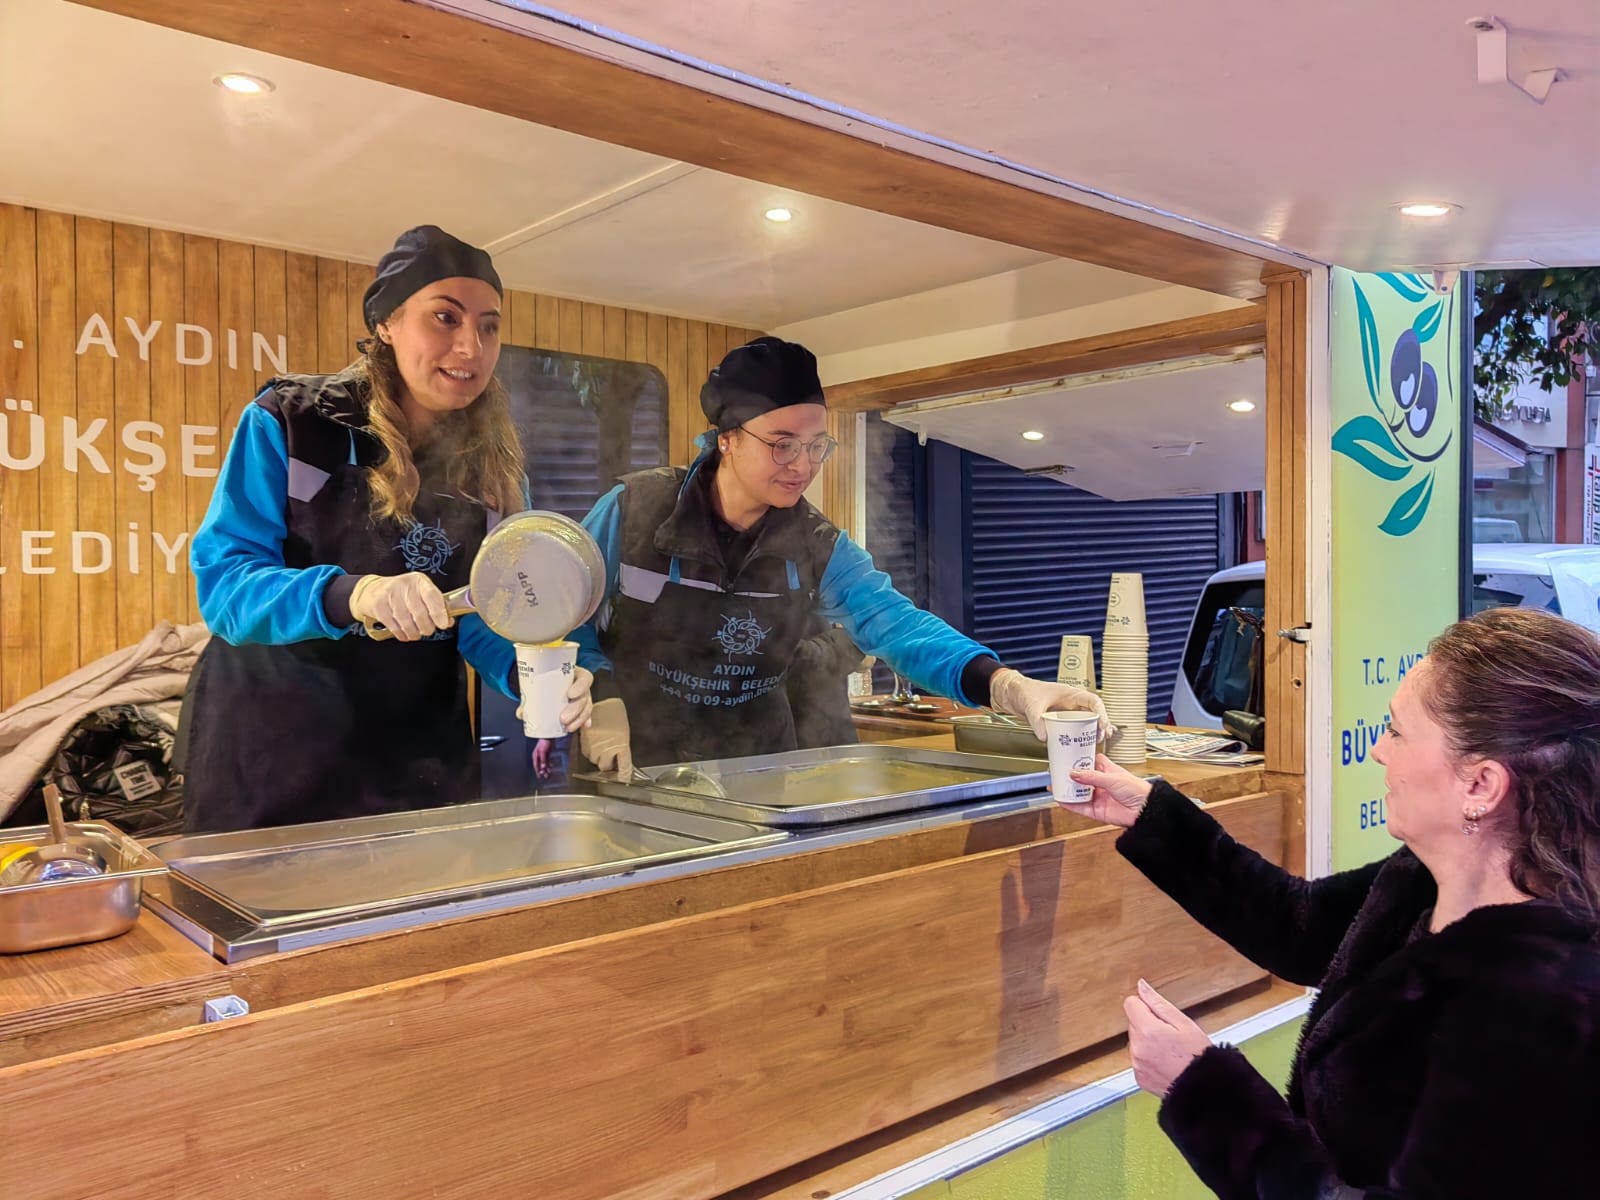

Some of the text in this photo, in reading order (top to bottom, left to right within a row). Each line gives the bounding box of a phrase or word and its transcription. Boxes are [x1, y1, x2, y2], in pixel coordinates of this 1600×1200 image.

[75, 313, 288, 374] AYDIN
[0, 398, 238, 492] ÜKŞE
[517, 571, 540, 608] KAPP
[648, 661, 731, 692] BÜYÜKŞEHİR
[712, 664, 756, 676] AYDIN
[1362, 657, 1390, 686] T.C.
[684, 693, 701, 704] 40
